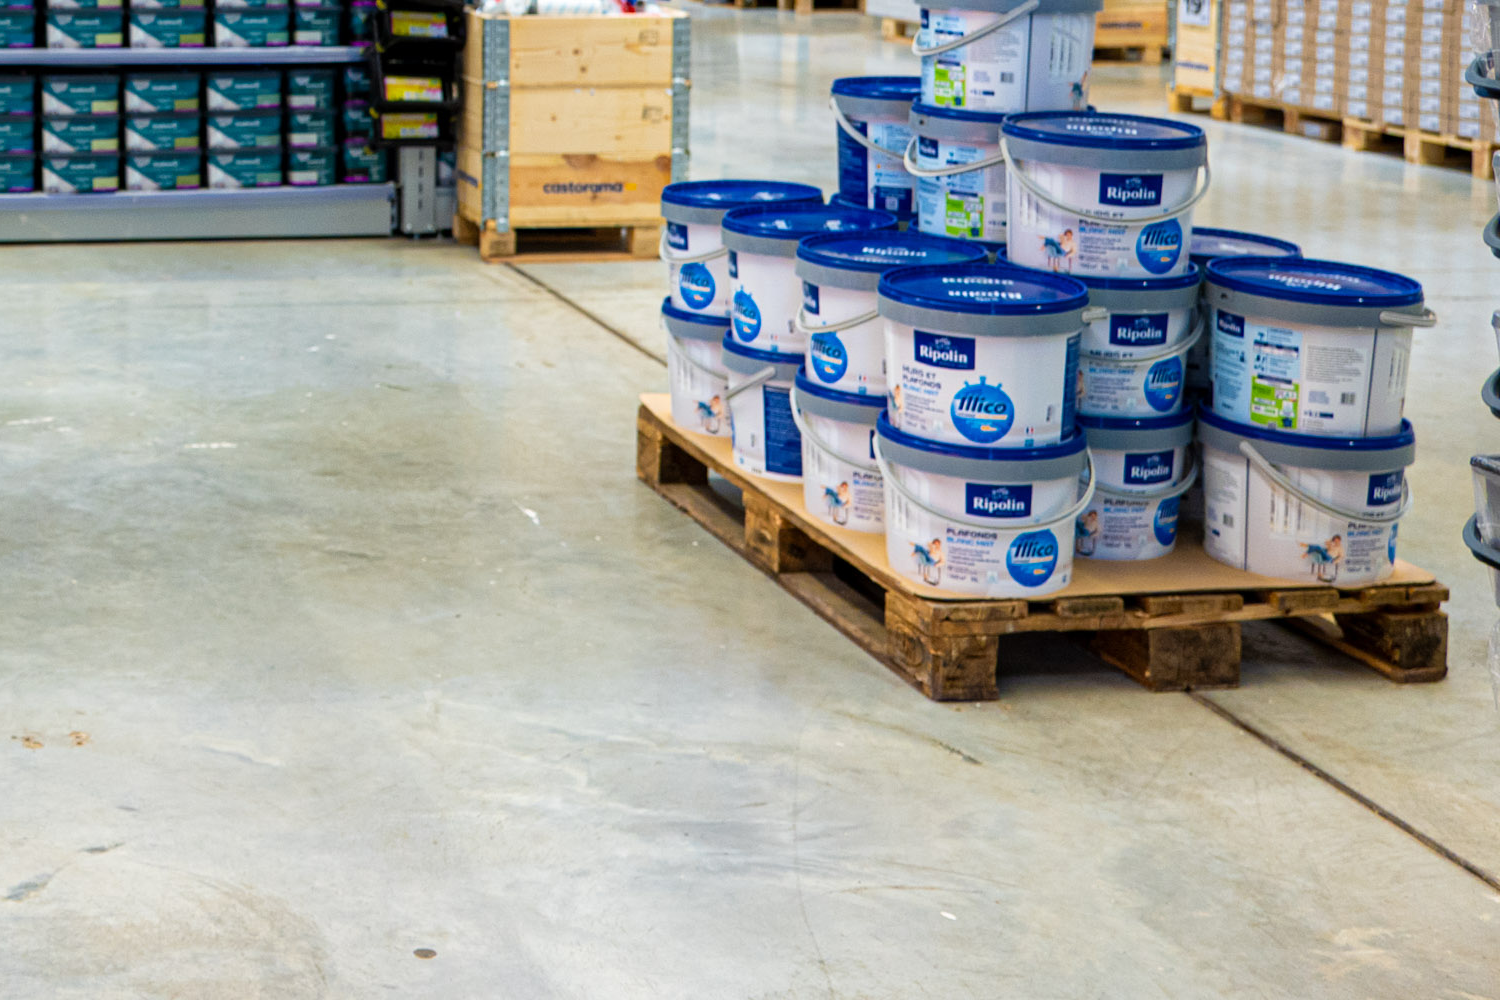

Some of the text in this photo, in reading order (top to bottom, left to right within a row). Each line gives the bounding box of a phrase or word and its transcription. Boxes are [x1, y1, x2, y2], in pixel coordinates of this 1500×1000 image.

[543, 182, 623, 194] castorama
[1107, 186, 1156, 203] Ripolin
[1144, 230, 1179, 246] Illico
[1117, 327, 1163, 343] Ripolin
[919, 344, 968, 364] Ripolin
[903, 374, 942, 390] PLAFONDS
[958, 394, 1007, 414] Illico
[1131, 465, 1171, 480] Ripolin
[973, 496, 1025, 513] Ripolin
[947, 528, 998, 540] PLAFONDS
[1014, 539, 1054, 558] Illico
